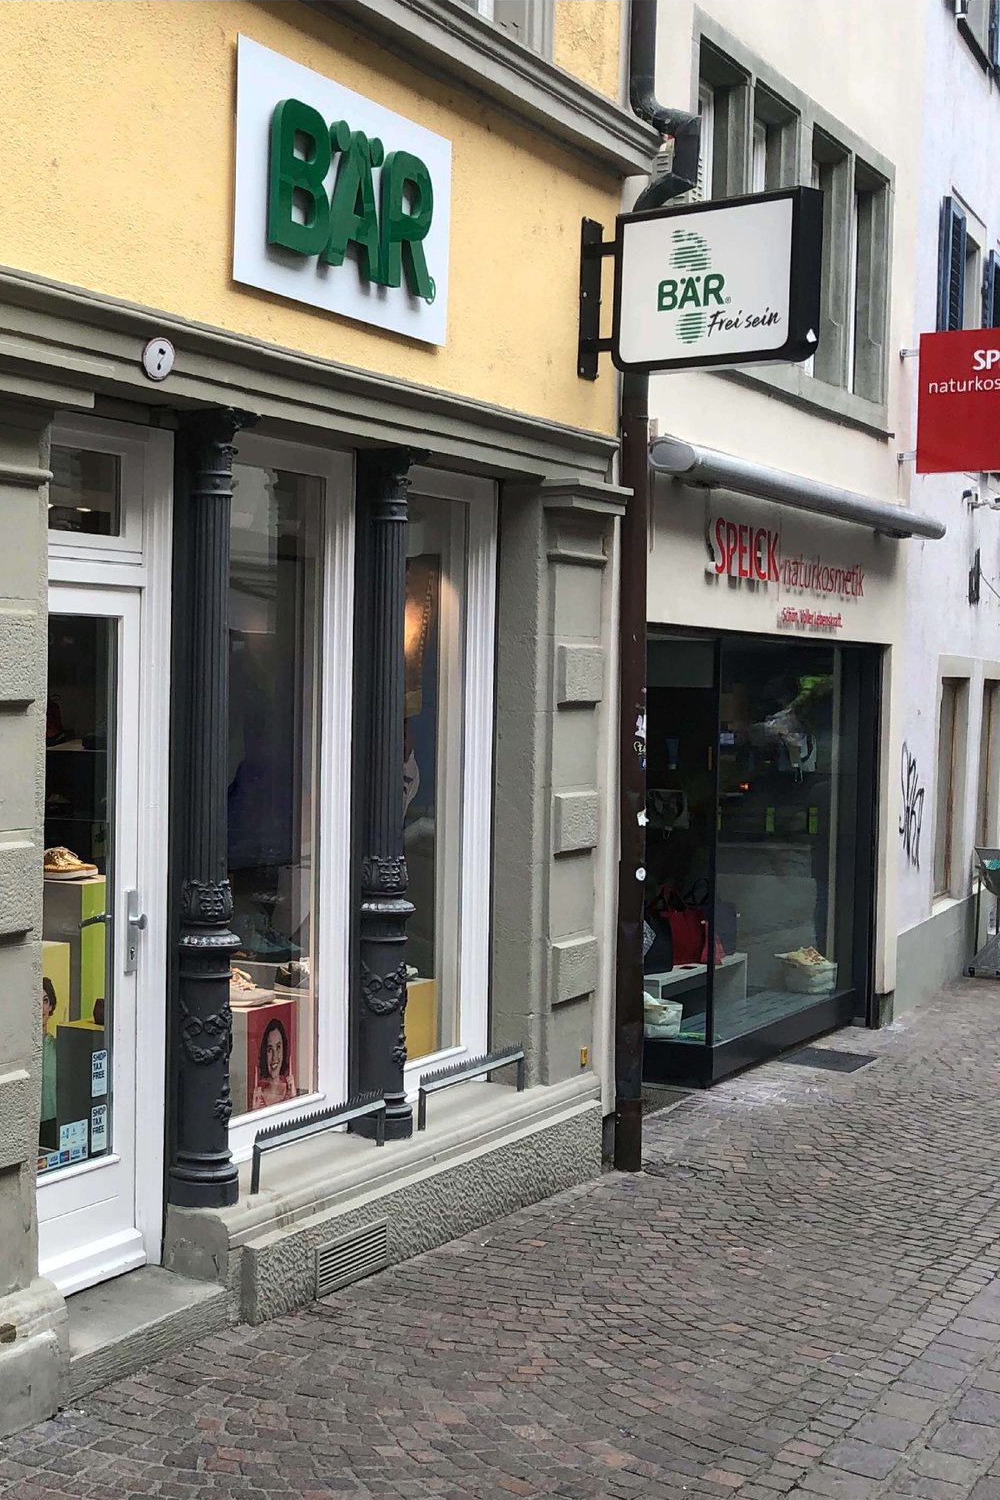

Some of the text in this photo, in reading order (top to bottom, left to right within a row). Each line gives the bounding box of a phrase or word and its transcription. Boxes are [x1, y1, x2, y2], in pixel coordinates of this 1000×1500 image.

[266, 98, 434, 299] BÄR
[657, 273, 726, 312] BÄR
[707, 307, 781, 338] Frei sein
[928, 376, 1000, 394] naturkos
[715, 517, 865, 596] SPEICK naturkosmetik
[93, 1052, 107, 1063] SHOP
[93, 1062, 103, 1071] TAX
[93, 1070, 105, 1081] FREE
[92, 1106, 106, 1118] SHOP
[92, 1117, 103, 1126] TAX
[92, 1125, 105, 1136] FREE
